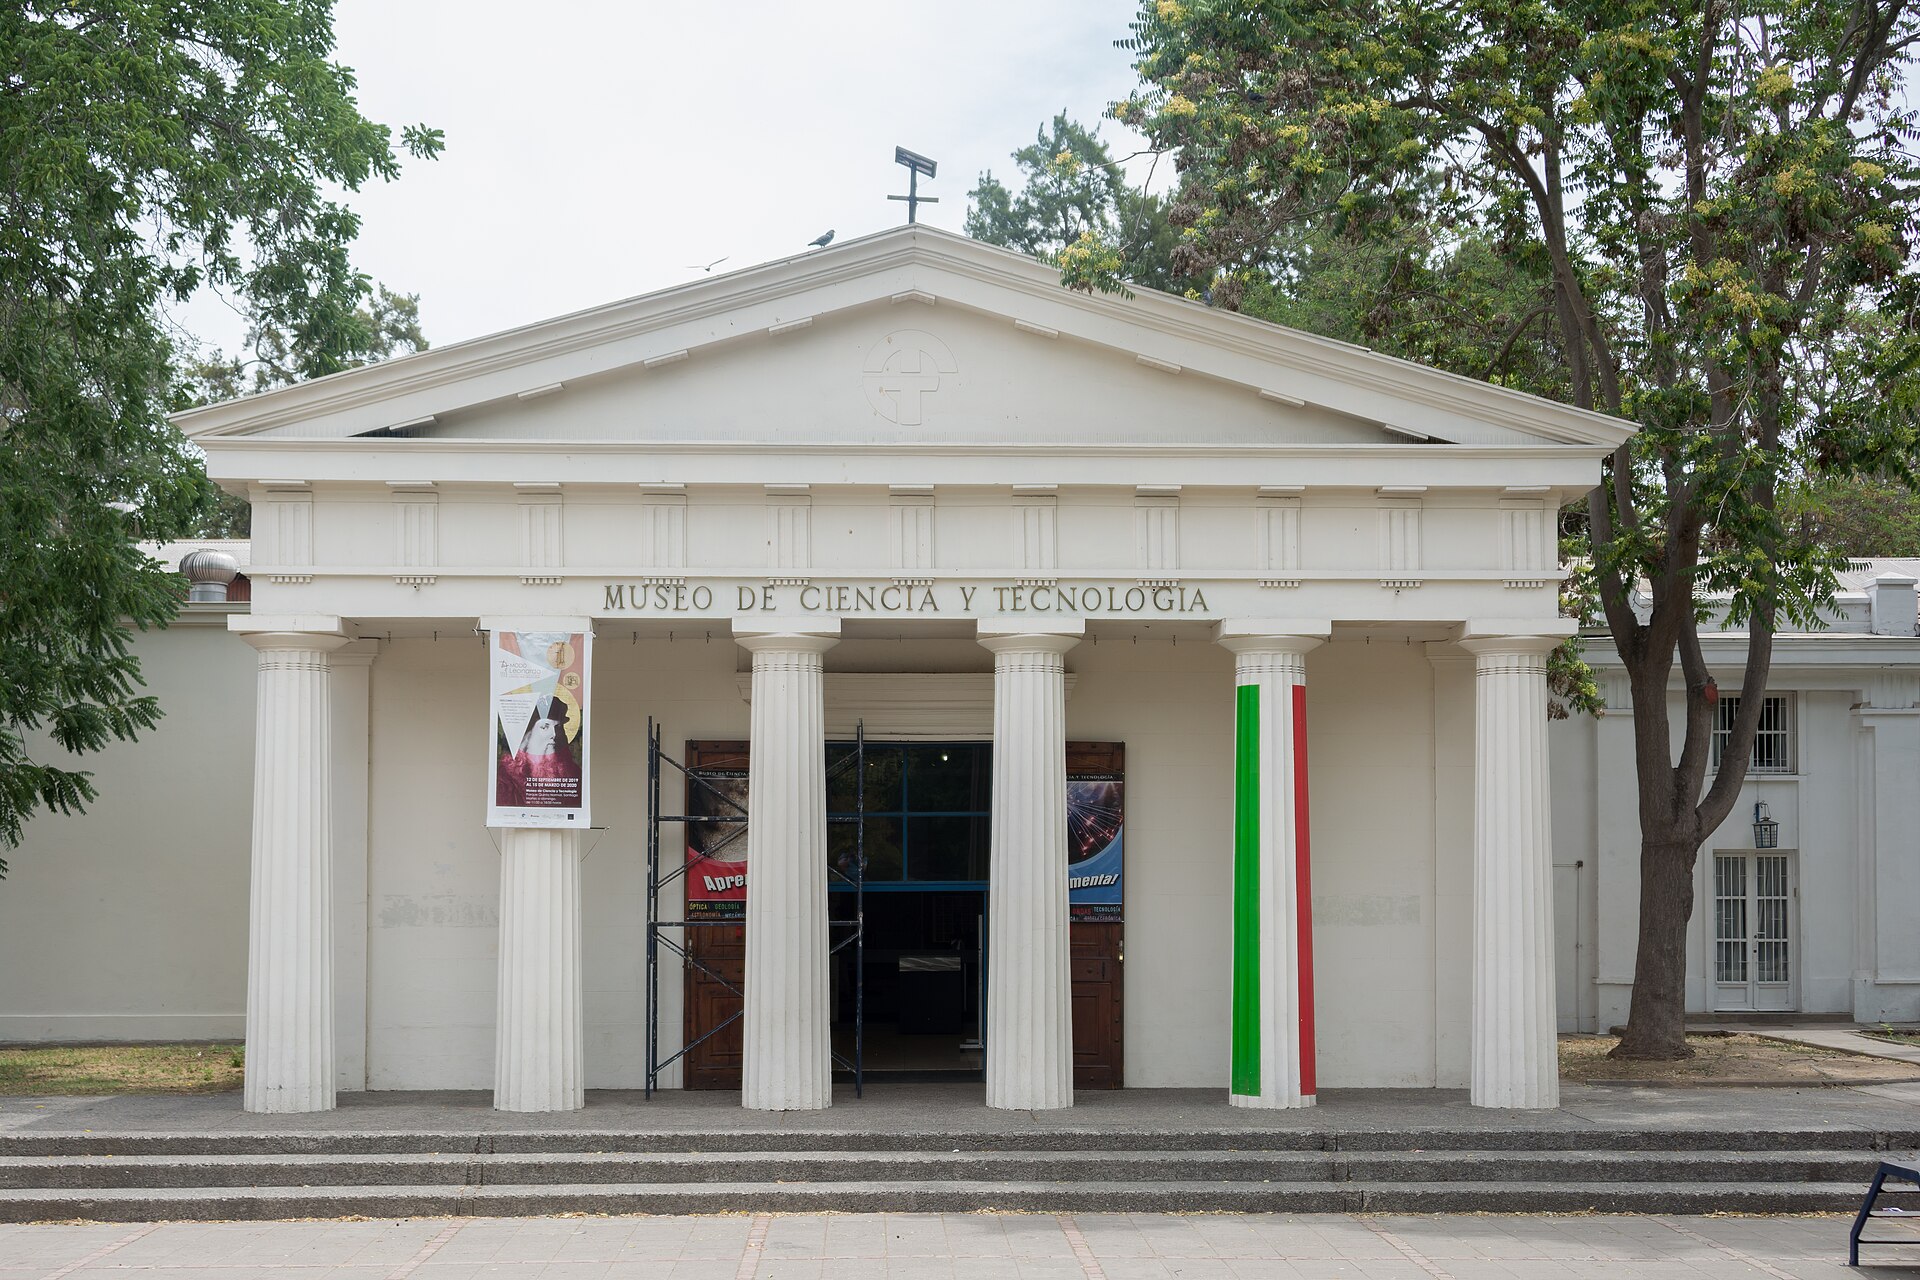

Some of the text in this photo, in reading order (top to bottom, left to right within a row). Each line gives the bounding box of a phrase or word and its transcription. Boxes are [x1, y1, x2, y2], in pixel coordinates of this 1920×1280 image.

[603, 585, 1210, 612] MUSEO DE CIENCIA Y TECNOLOGIA
